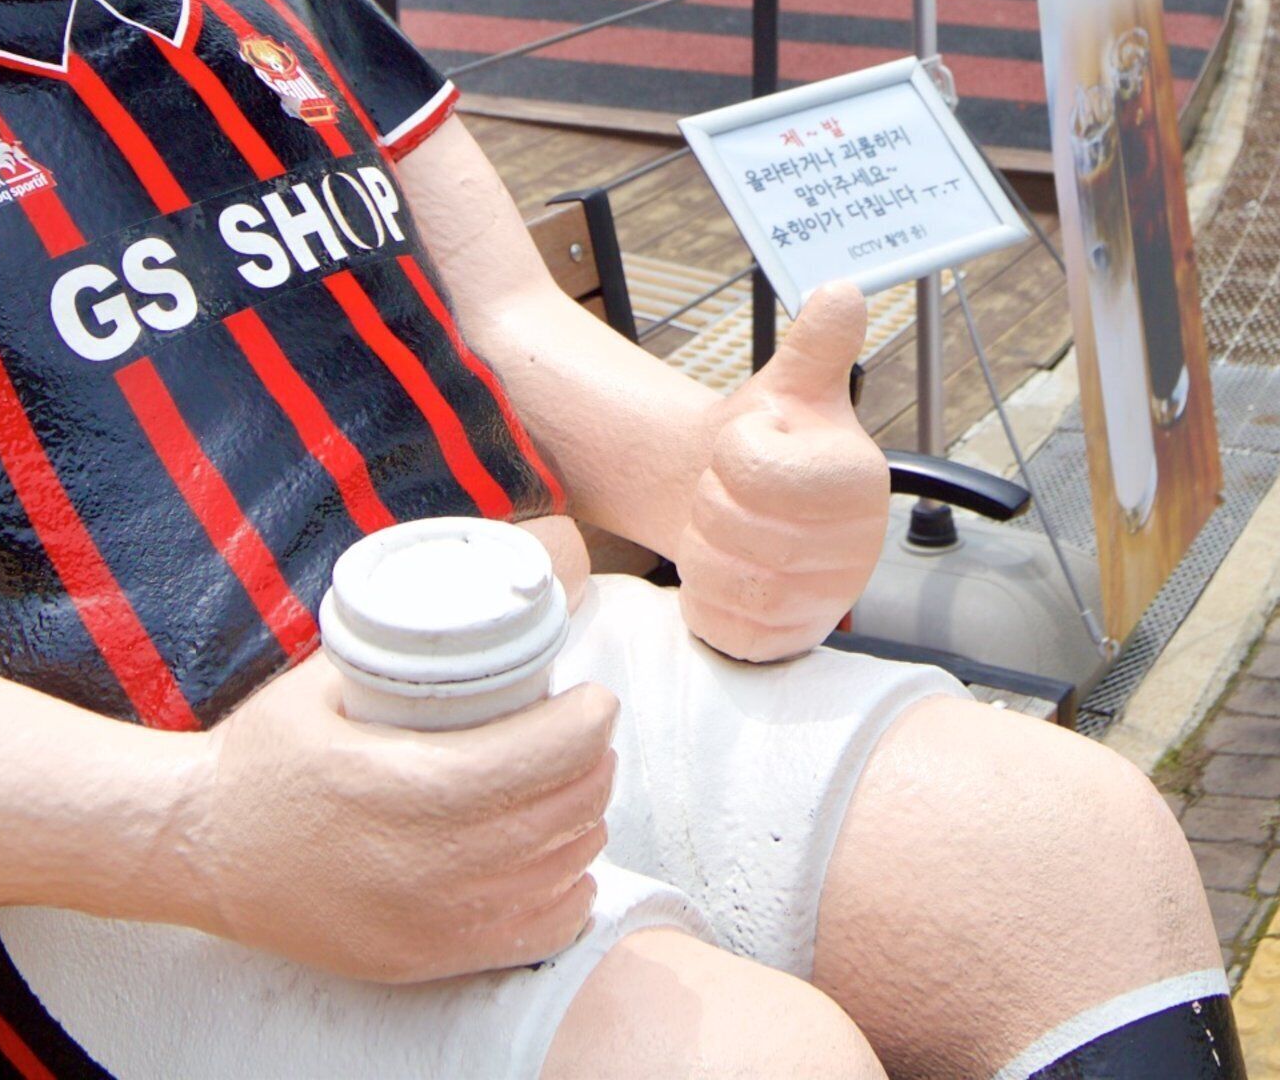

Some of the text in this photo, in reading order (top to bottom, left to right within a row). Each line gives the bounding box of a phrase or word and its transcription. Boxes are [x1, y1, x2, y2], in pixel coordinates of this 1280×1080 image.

[9, 172, 49, 198] sportif
[744, 125, 912, 193] 올라타거나 괴롭히지
[845, 184, 918, 220] 다칩니다
[49, 166, 406, 362] GS SHOP
